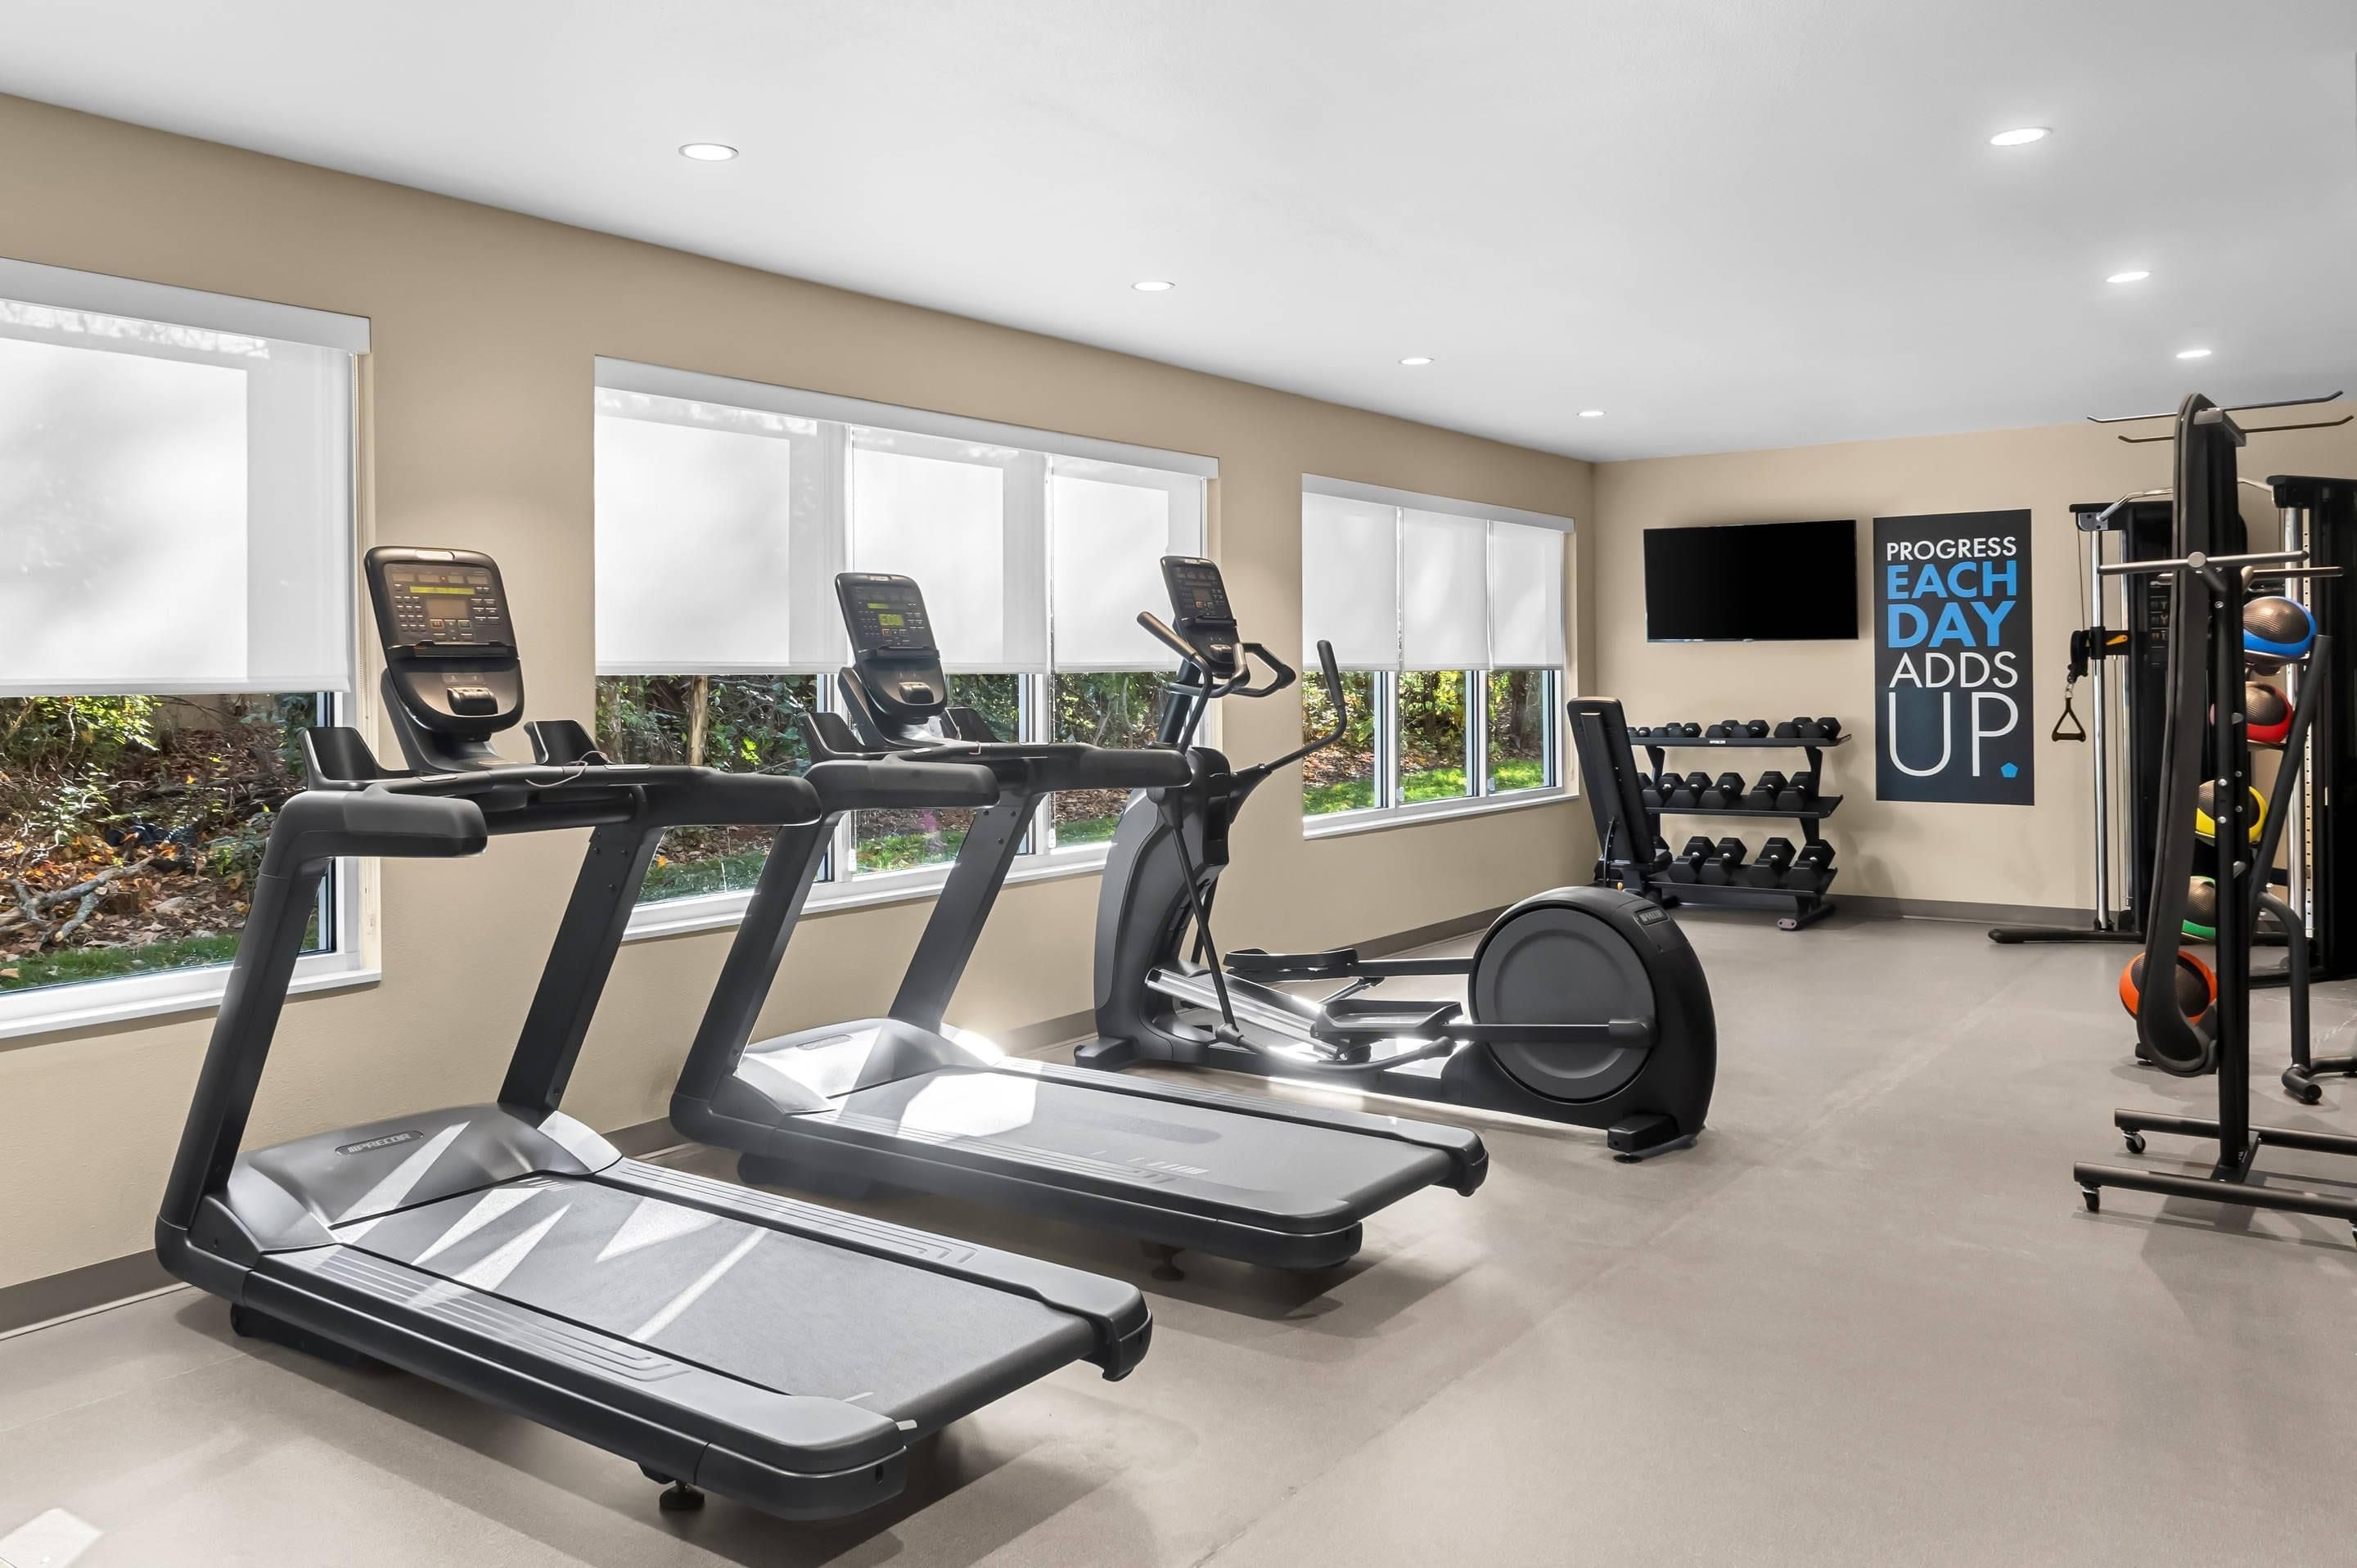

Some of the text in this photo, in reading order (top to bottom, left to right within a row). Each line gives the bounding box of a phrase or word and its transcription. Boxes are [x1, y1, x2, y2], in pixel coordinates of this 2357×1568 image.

[1886, 536, 2017, 561] PROGRESS
[1886, 561, 2017, 599] EACH
[1888, 601, 2016, 648] DAY
[1889, 651, 2018, 688] ADDS
